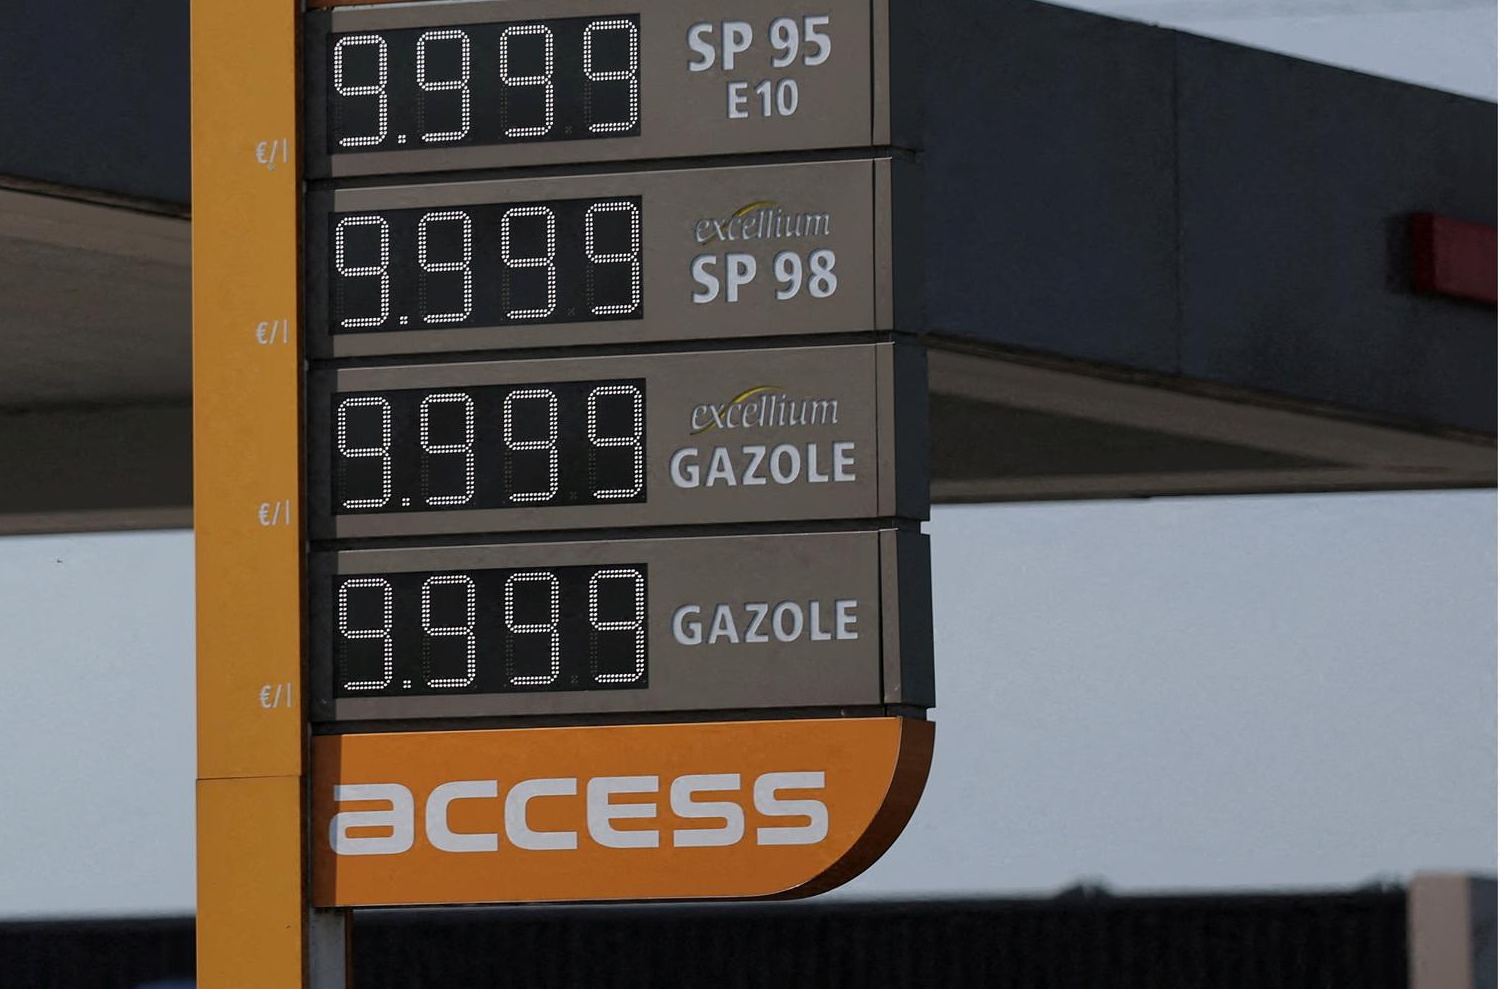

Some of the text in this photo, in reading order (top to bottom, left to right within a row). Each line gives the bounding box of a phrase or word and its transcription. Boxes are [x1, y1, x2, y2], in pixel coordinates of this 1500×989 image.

[687, 15, 832, 72] SP 95
[333, 19, 638, 147] 9.999
[695, 209, 830, 243] excellium
[335, 200, 640, 328] 9.999
[691, 248, 838, 304] SP 98
[691, 393, 839, 430] excellium
[337, 384, 643, 509] 9.999
[669, 441, 856, 489] GAZOLE
[338, 568, 645, 690] 9.999
[671, 599, 859, 646] GAZOLE
